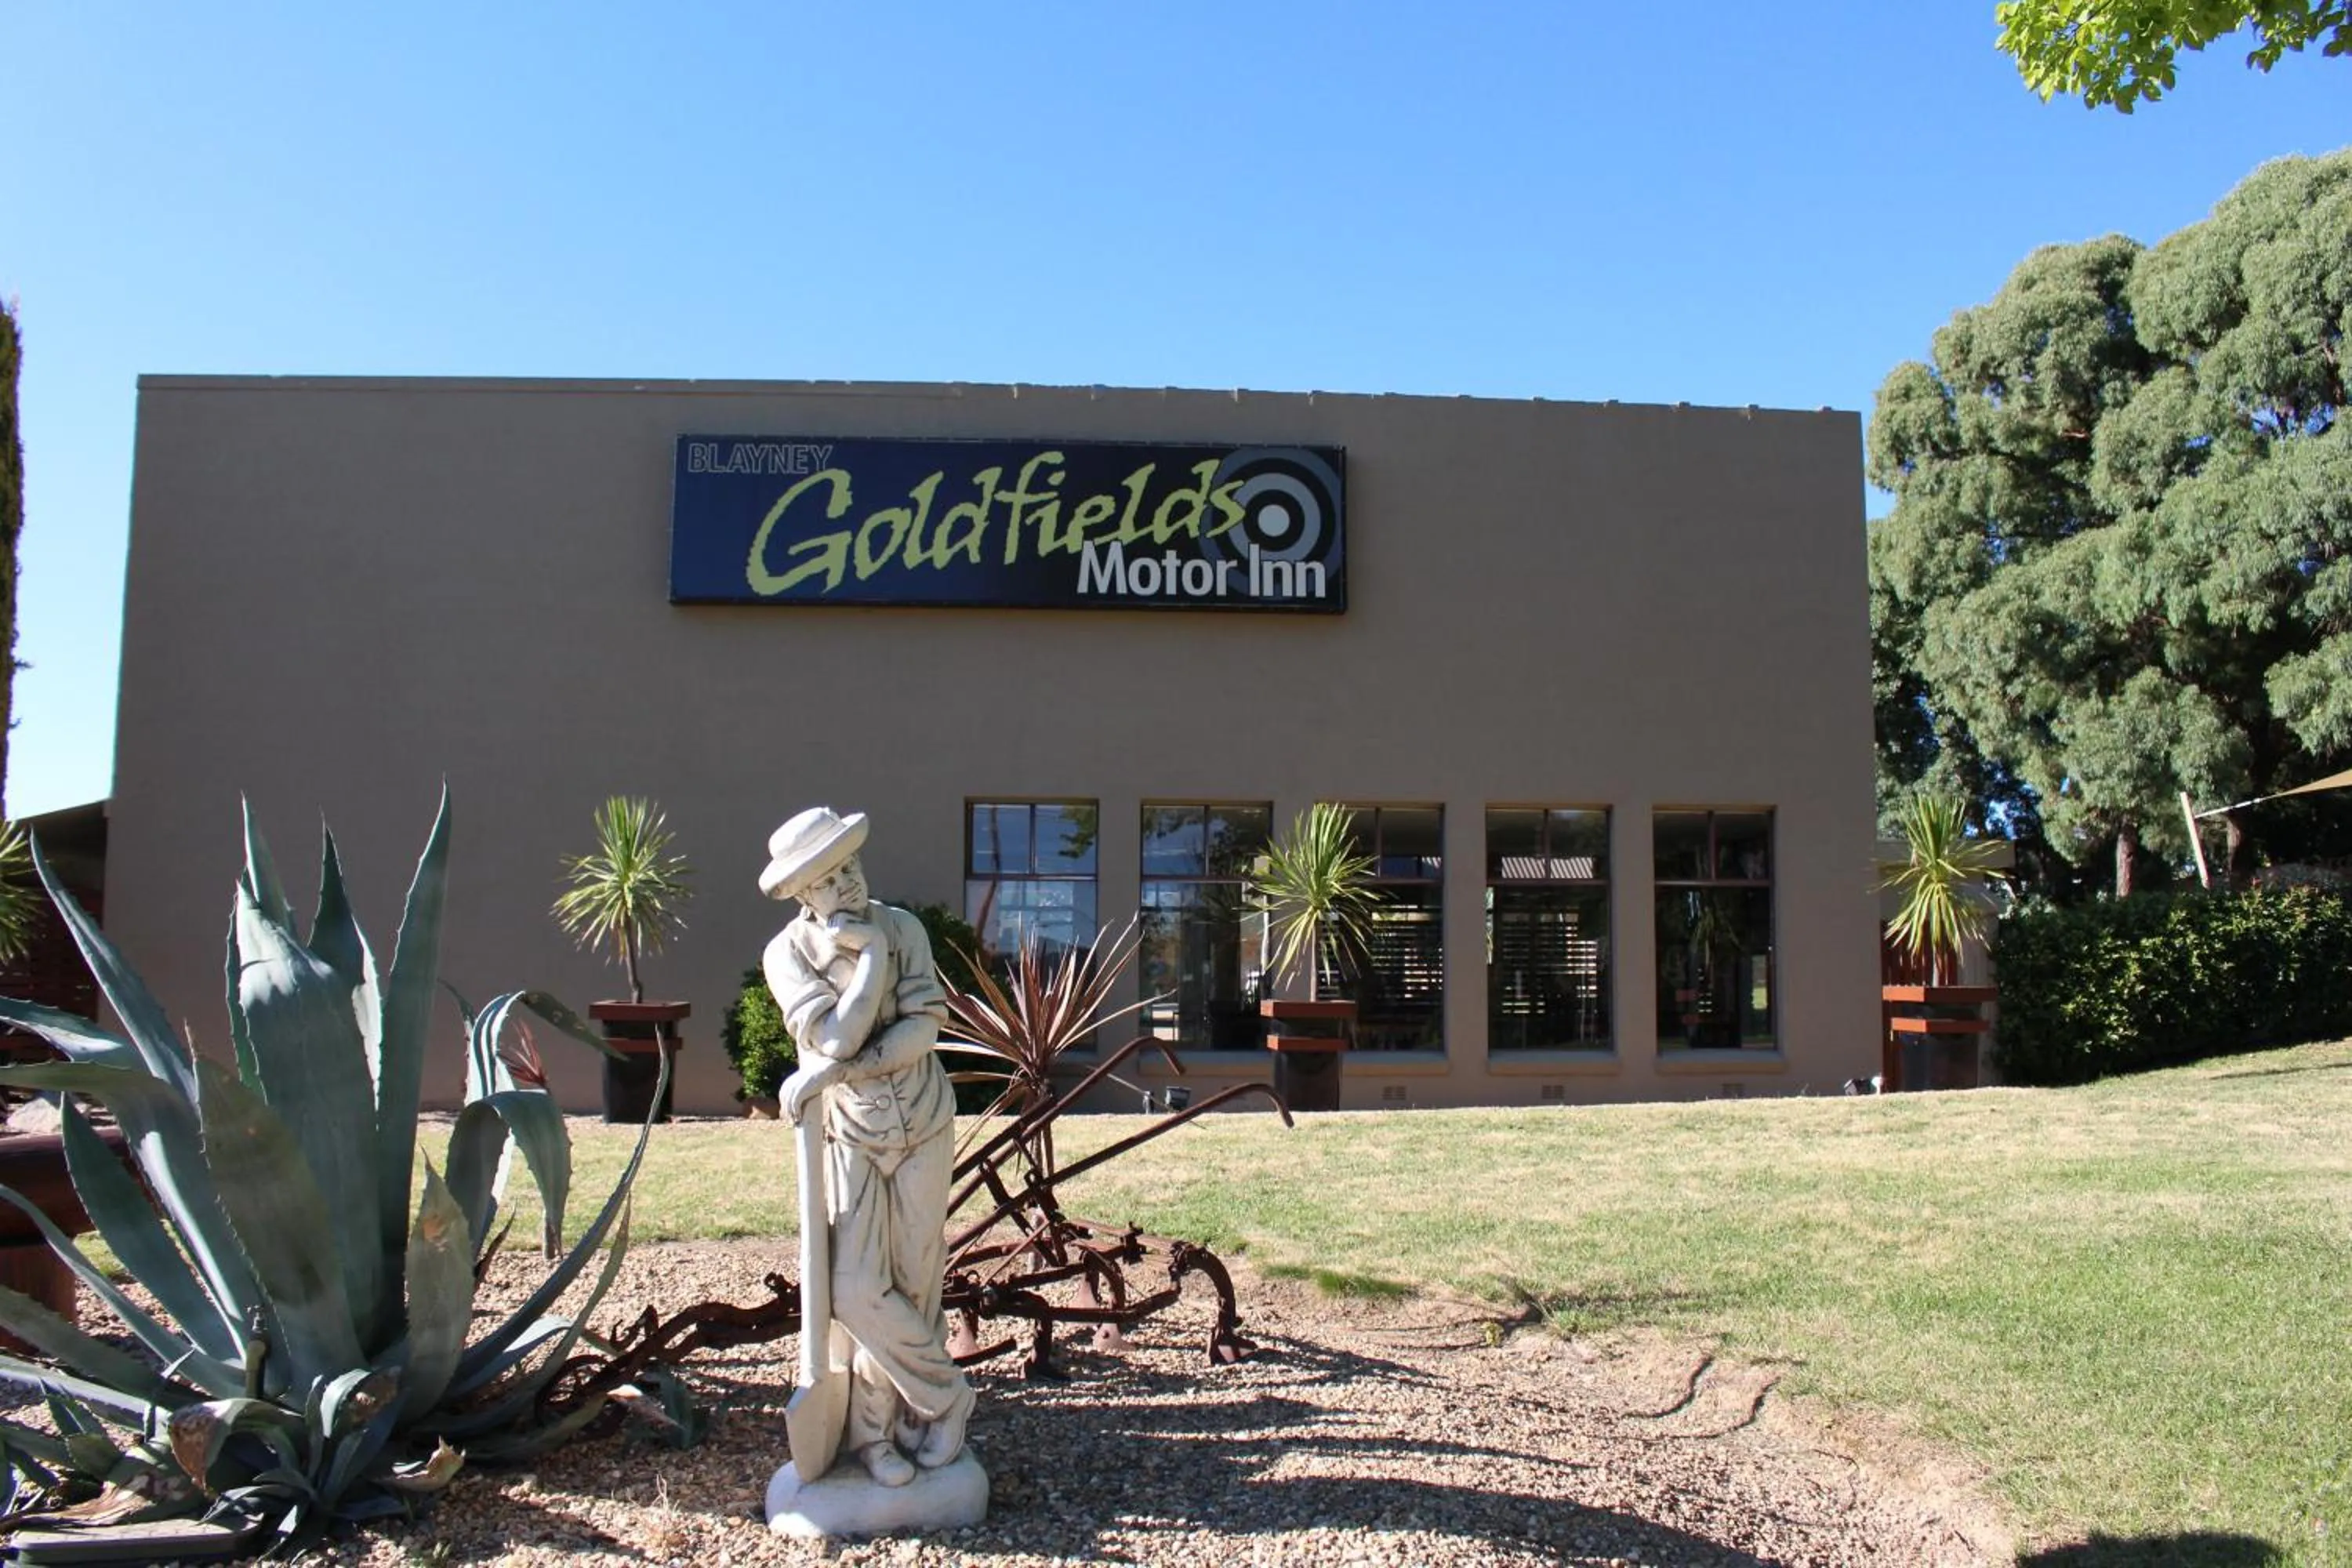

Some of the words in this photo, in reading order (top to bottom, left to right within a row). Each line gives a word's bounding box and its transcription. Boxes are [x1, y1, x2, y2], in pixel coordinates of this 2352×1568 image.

[687, 441, 833, 475] BLAYNEY
[746, 450, 1245, 597] Goldfields
[1076, 539, 1238, 597] Motor
[1248, 543, 1327, 598] Inn
